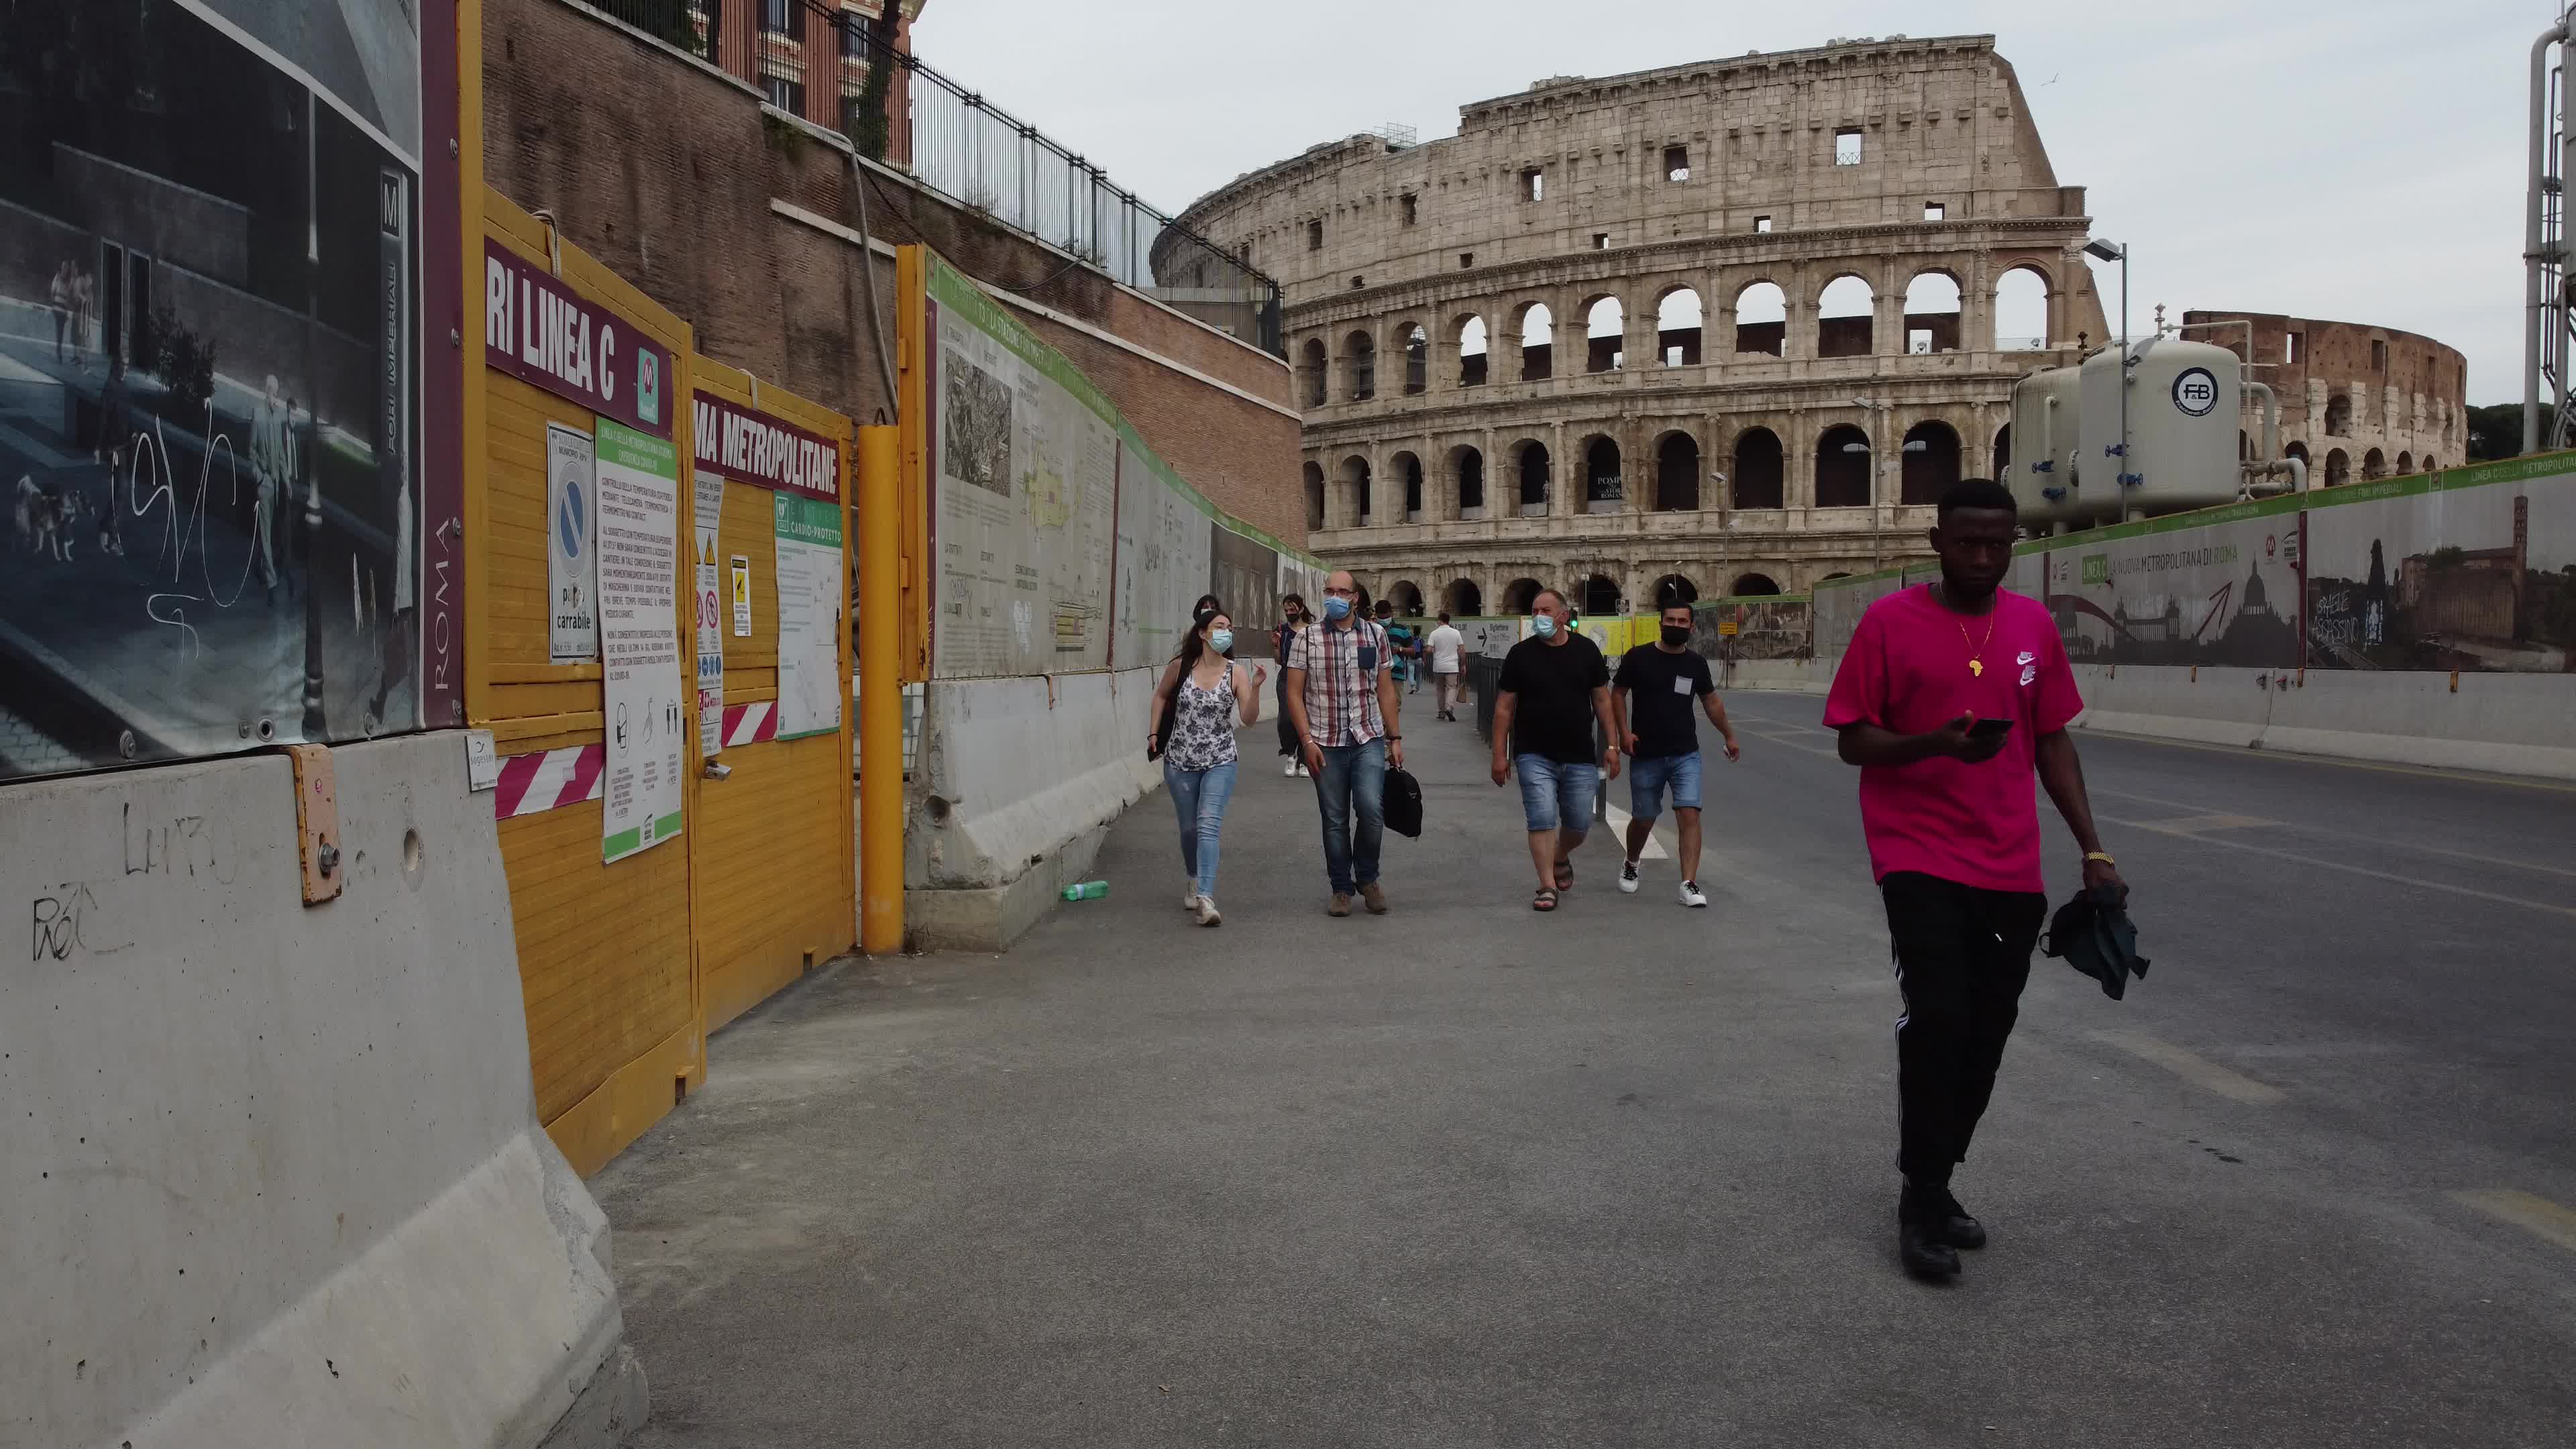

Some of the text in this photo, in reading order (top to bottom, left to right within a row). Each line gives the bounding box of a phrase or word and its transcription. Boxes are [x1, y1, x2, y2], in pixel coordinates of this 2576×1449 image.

[487, 256, 614, 401] RI LINEA C
[386, 262, 397, 455] FORI IMPERIALI
[722, 411, 837, 494] METROPOLITANE
[2523, 456, 2576, 474] METROPOLITA
[791, 521, 842, 542] CARDIO-PROTETTO
[2141, 550, 2201, 571] METROPOLITANA
[2203, 551, 2212, 566] DI
[2214, 545, 2238, 564] ROMA
[435, 519, 450, 690] ROMA
[557, 611, 591, 629] carrabile
